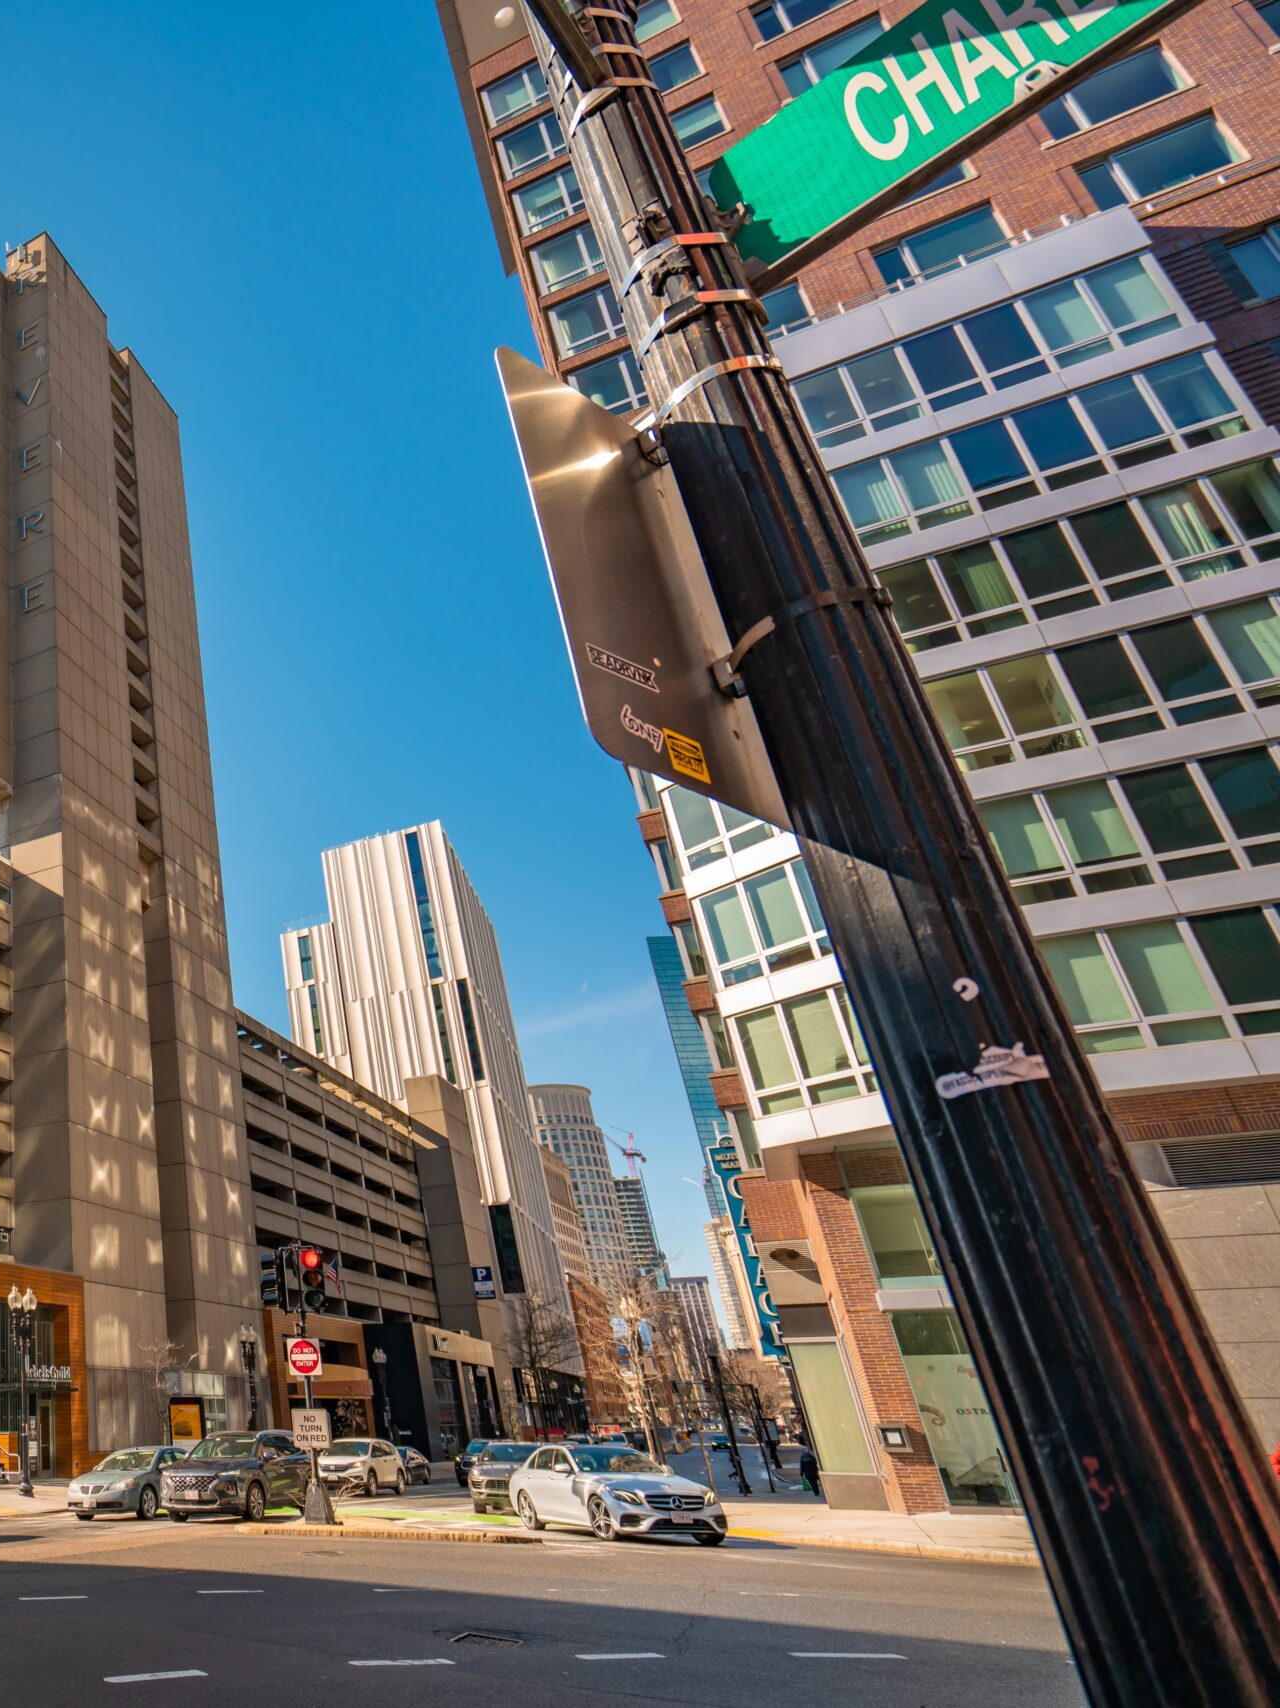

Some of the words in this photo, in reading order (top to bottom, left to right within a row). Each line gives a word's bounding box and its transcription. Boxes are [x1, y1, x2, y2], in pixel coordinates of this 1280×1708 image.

[15, 266, 46, 614] REVERE
[476, 1268, 487, 1281] P
[303, 1415, 316, 1423] NO
[299, 1425, 322, 1433] TURN
